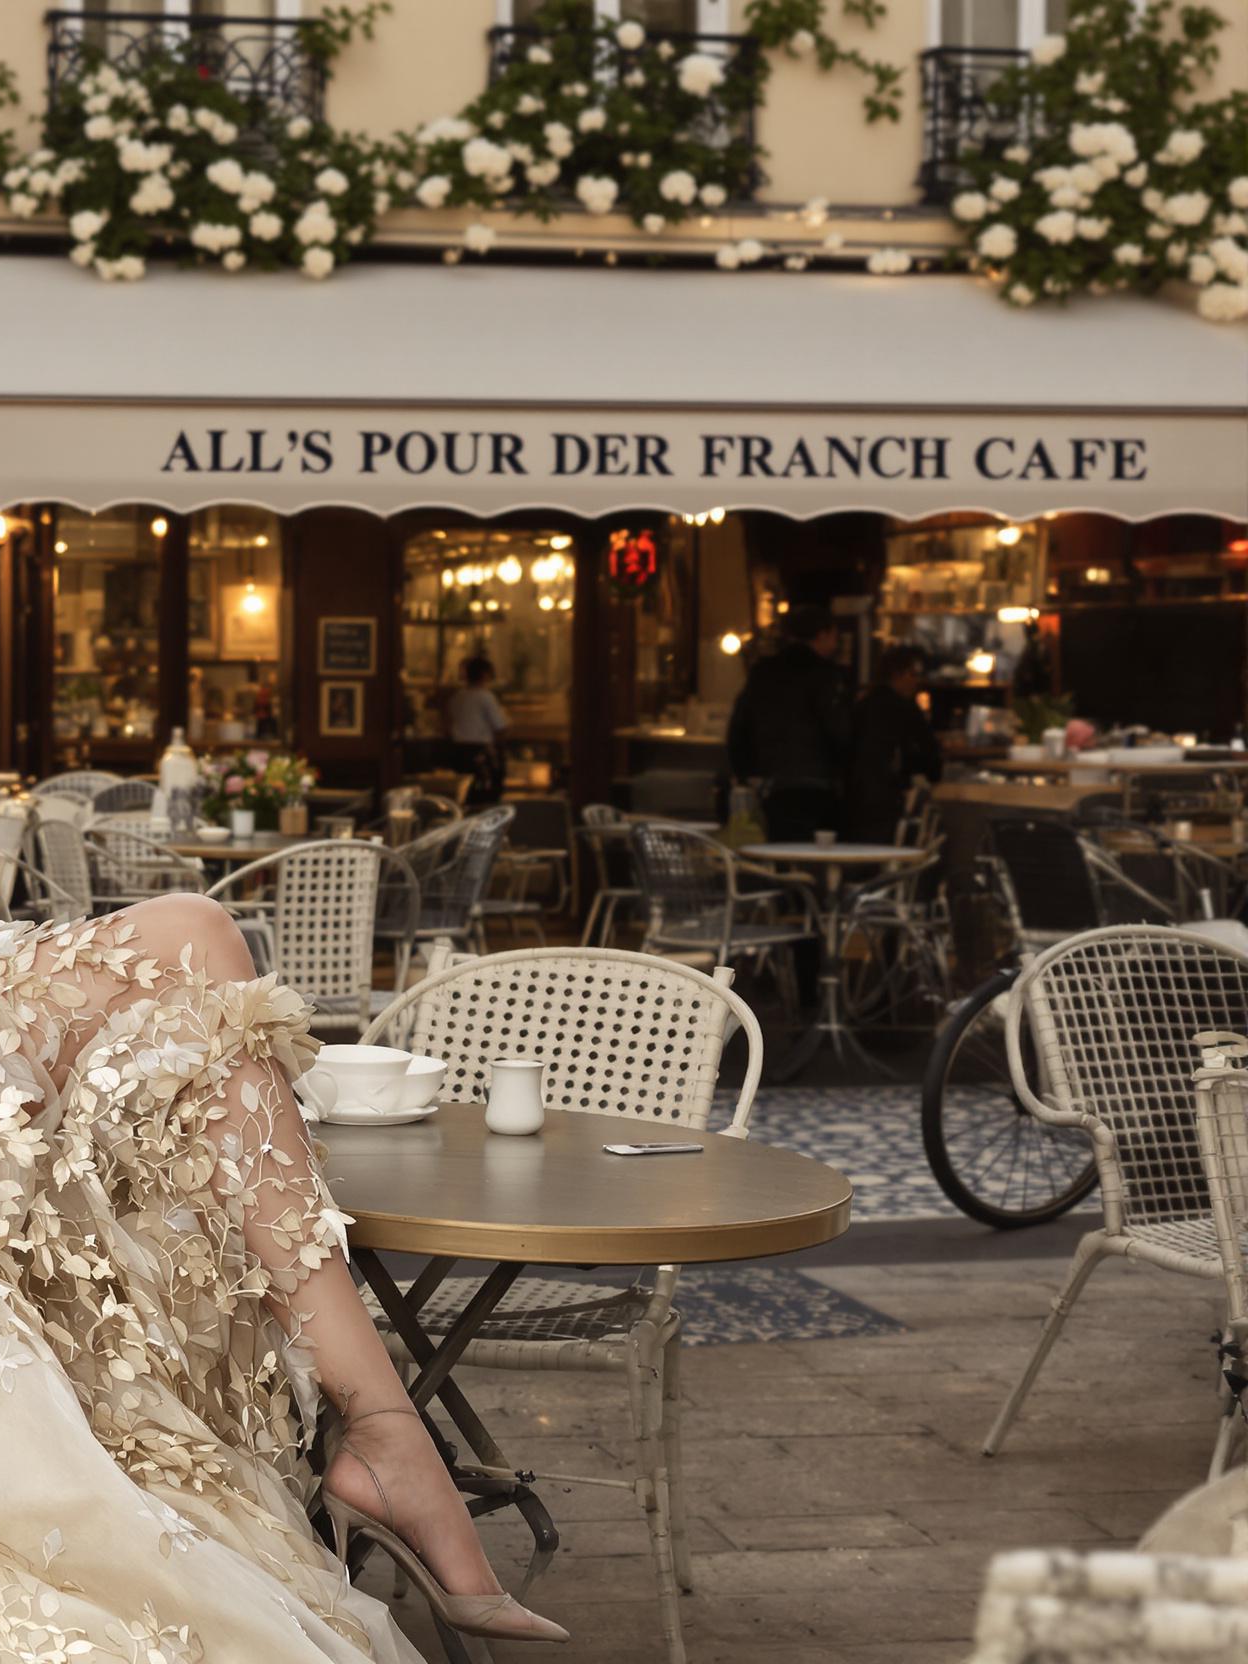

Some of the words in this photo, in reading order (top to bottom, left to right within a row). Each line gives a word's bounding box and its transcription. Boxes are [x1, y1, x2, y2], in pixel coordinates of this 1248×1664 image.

[161, 430, 333, 473] ALL'S
[358, 430, 528, 476] POUR
[551, 433, 673, 477] DER
[700, 435, 950, 480] FRANCH
[974, 437, 1148, 482] CAFE
